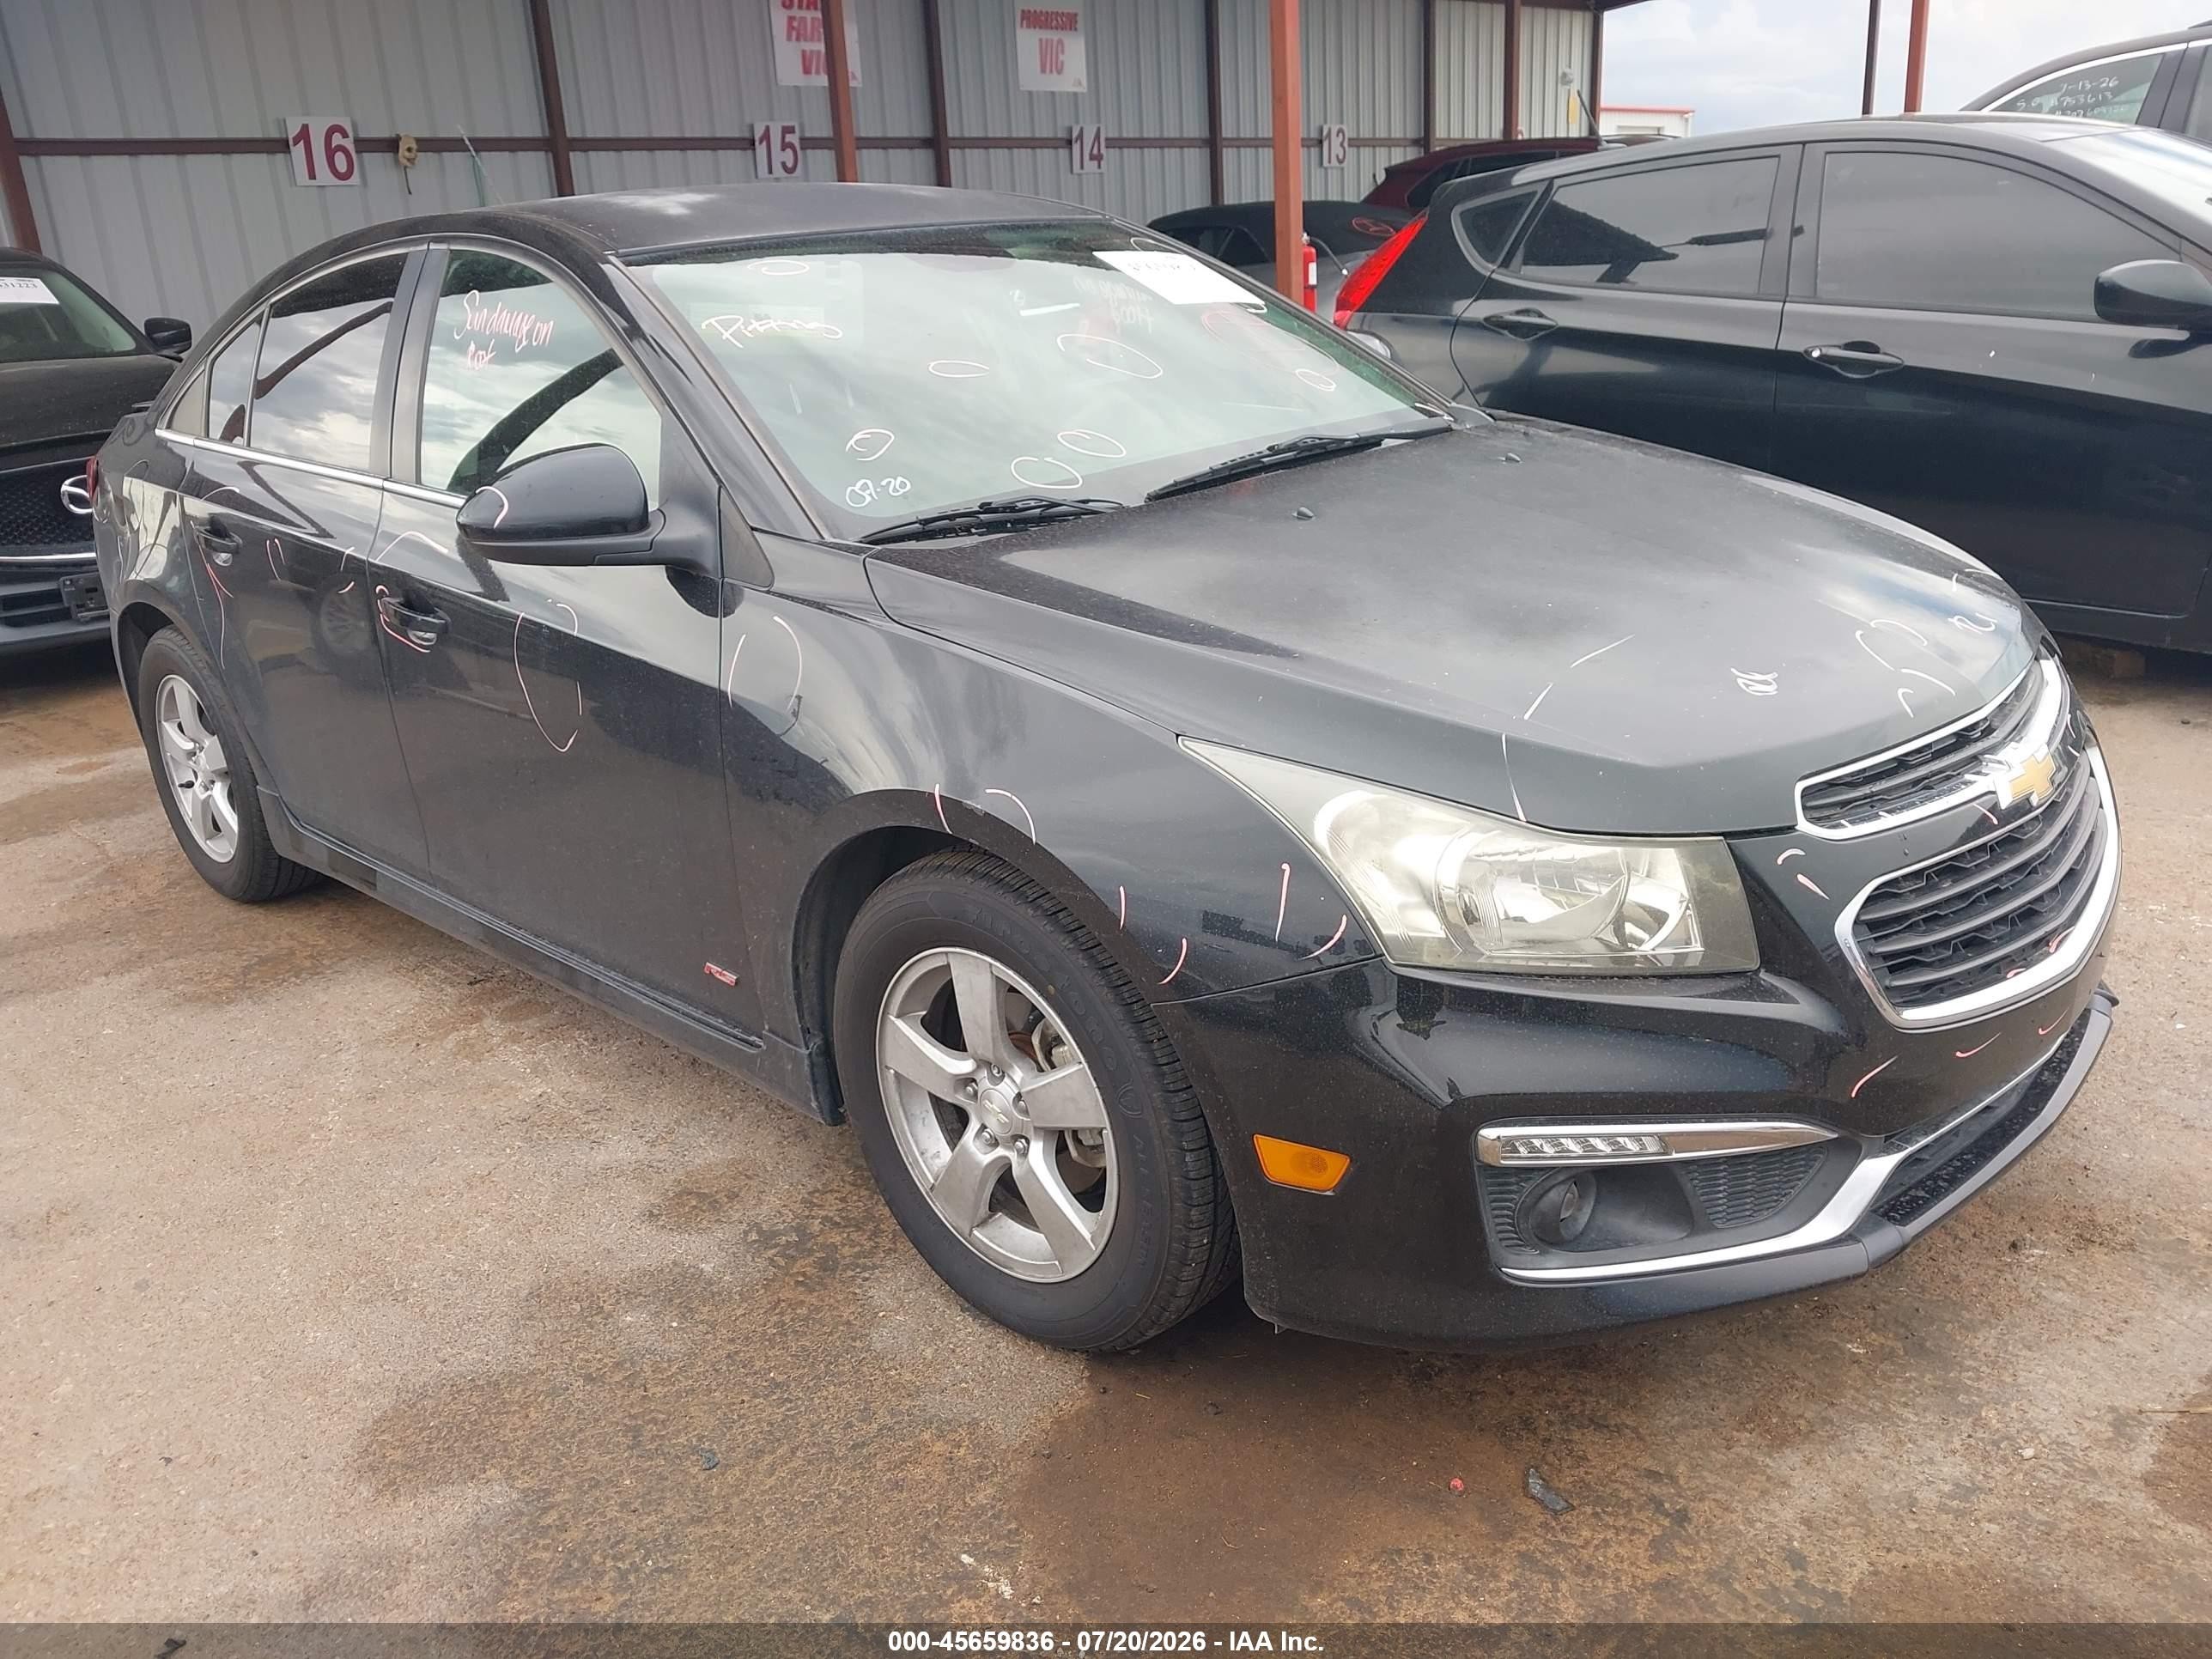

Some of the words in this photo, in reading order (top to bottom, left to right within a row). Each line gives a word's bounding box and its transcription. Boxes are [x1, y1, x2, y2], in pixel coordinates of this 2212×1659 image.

[785, 15, 823, 42] FAR
[1019, 9, 1079, 32] PROGRESSIVE
[1038, 37, 1065, 76] VIC
[292, 123, 355, 182] 16
[758, 125, 799, 175] 15
[1074, 125, 1104, 171] 14
[1323, 126, 1346, 165] 13
